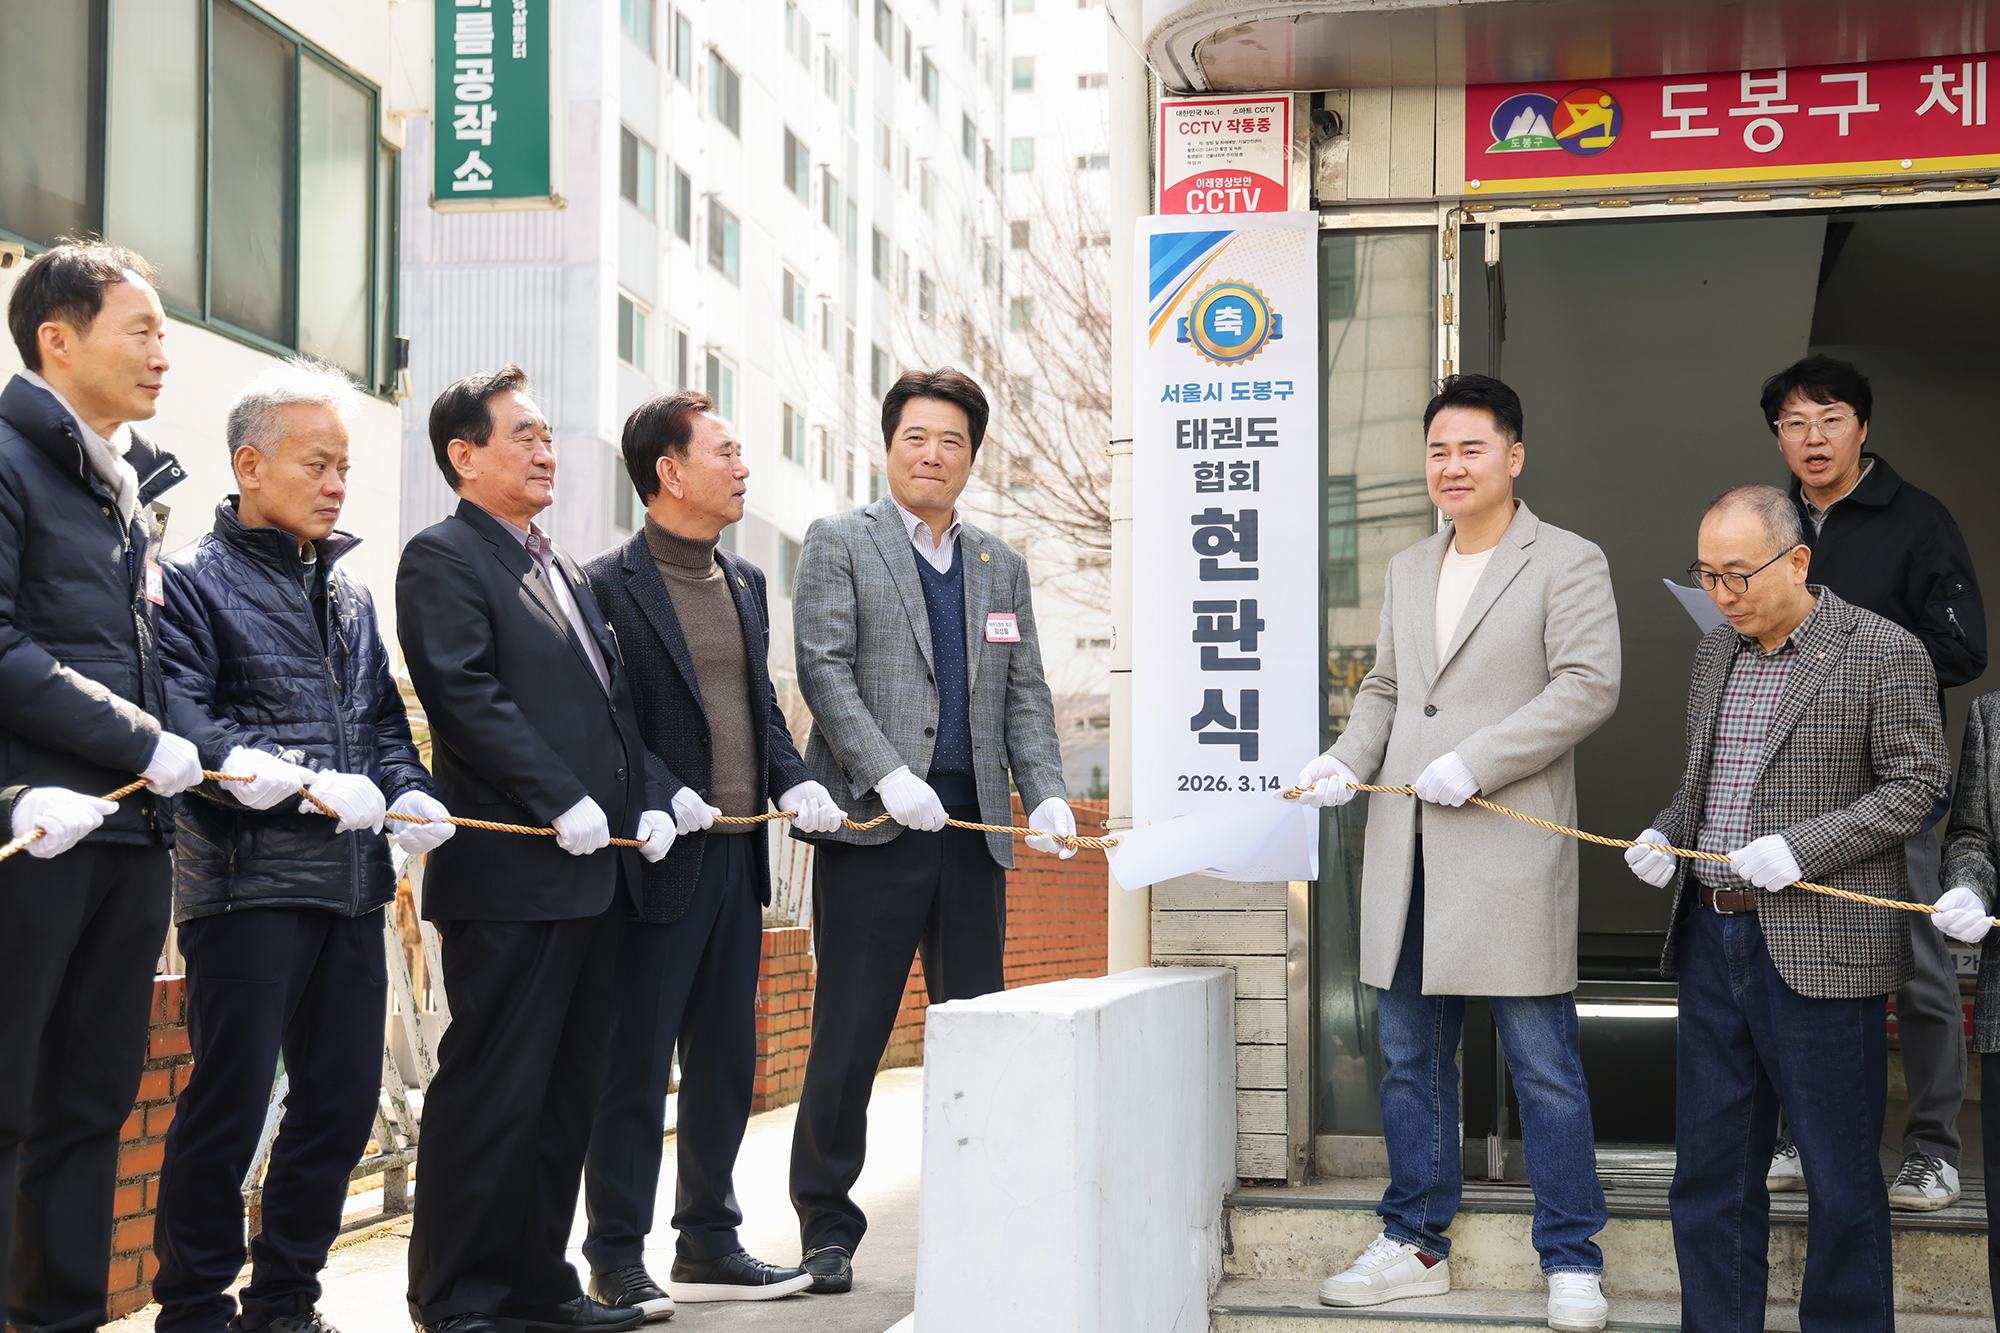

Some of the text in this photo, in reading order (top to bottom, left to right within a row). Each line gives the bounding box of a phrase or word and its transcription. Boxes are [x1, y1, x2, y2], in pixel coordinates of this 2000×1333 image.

[452, 0, 497, 192] 름공작소
[1176, 106, 1276, 117] 대한민국 No.1 스마트 CCTV
[1649, 69, 1881, 153] 도봉구
[1179, 117, 1271, 135] CCTV 작동중
[1510, 136, 1544, 149] 도봉구
[1196, 176, 1253, 189] 이레영상보안
[1186, 187, 1262, 214] CCTV
[1213, 306, 1243, 336] 축
[1160, 380, 1295, 404] 서울시 도봉구
[1176, 416, 1279, 450] 태권도
[1193, 460, 1260, 493] 협회
[1177, 774, 1233, 792] 2026.
